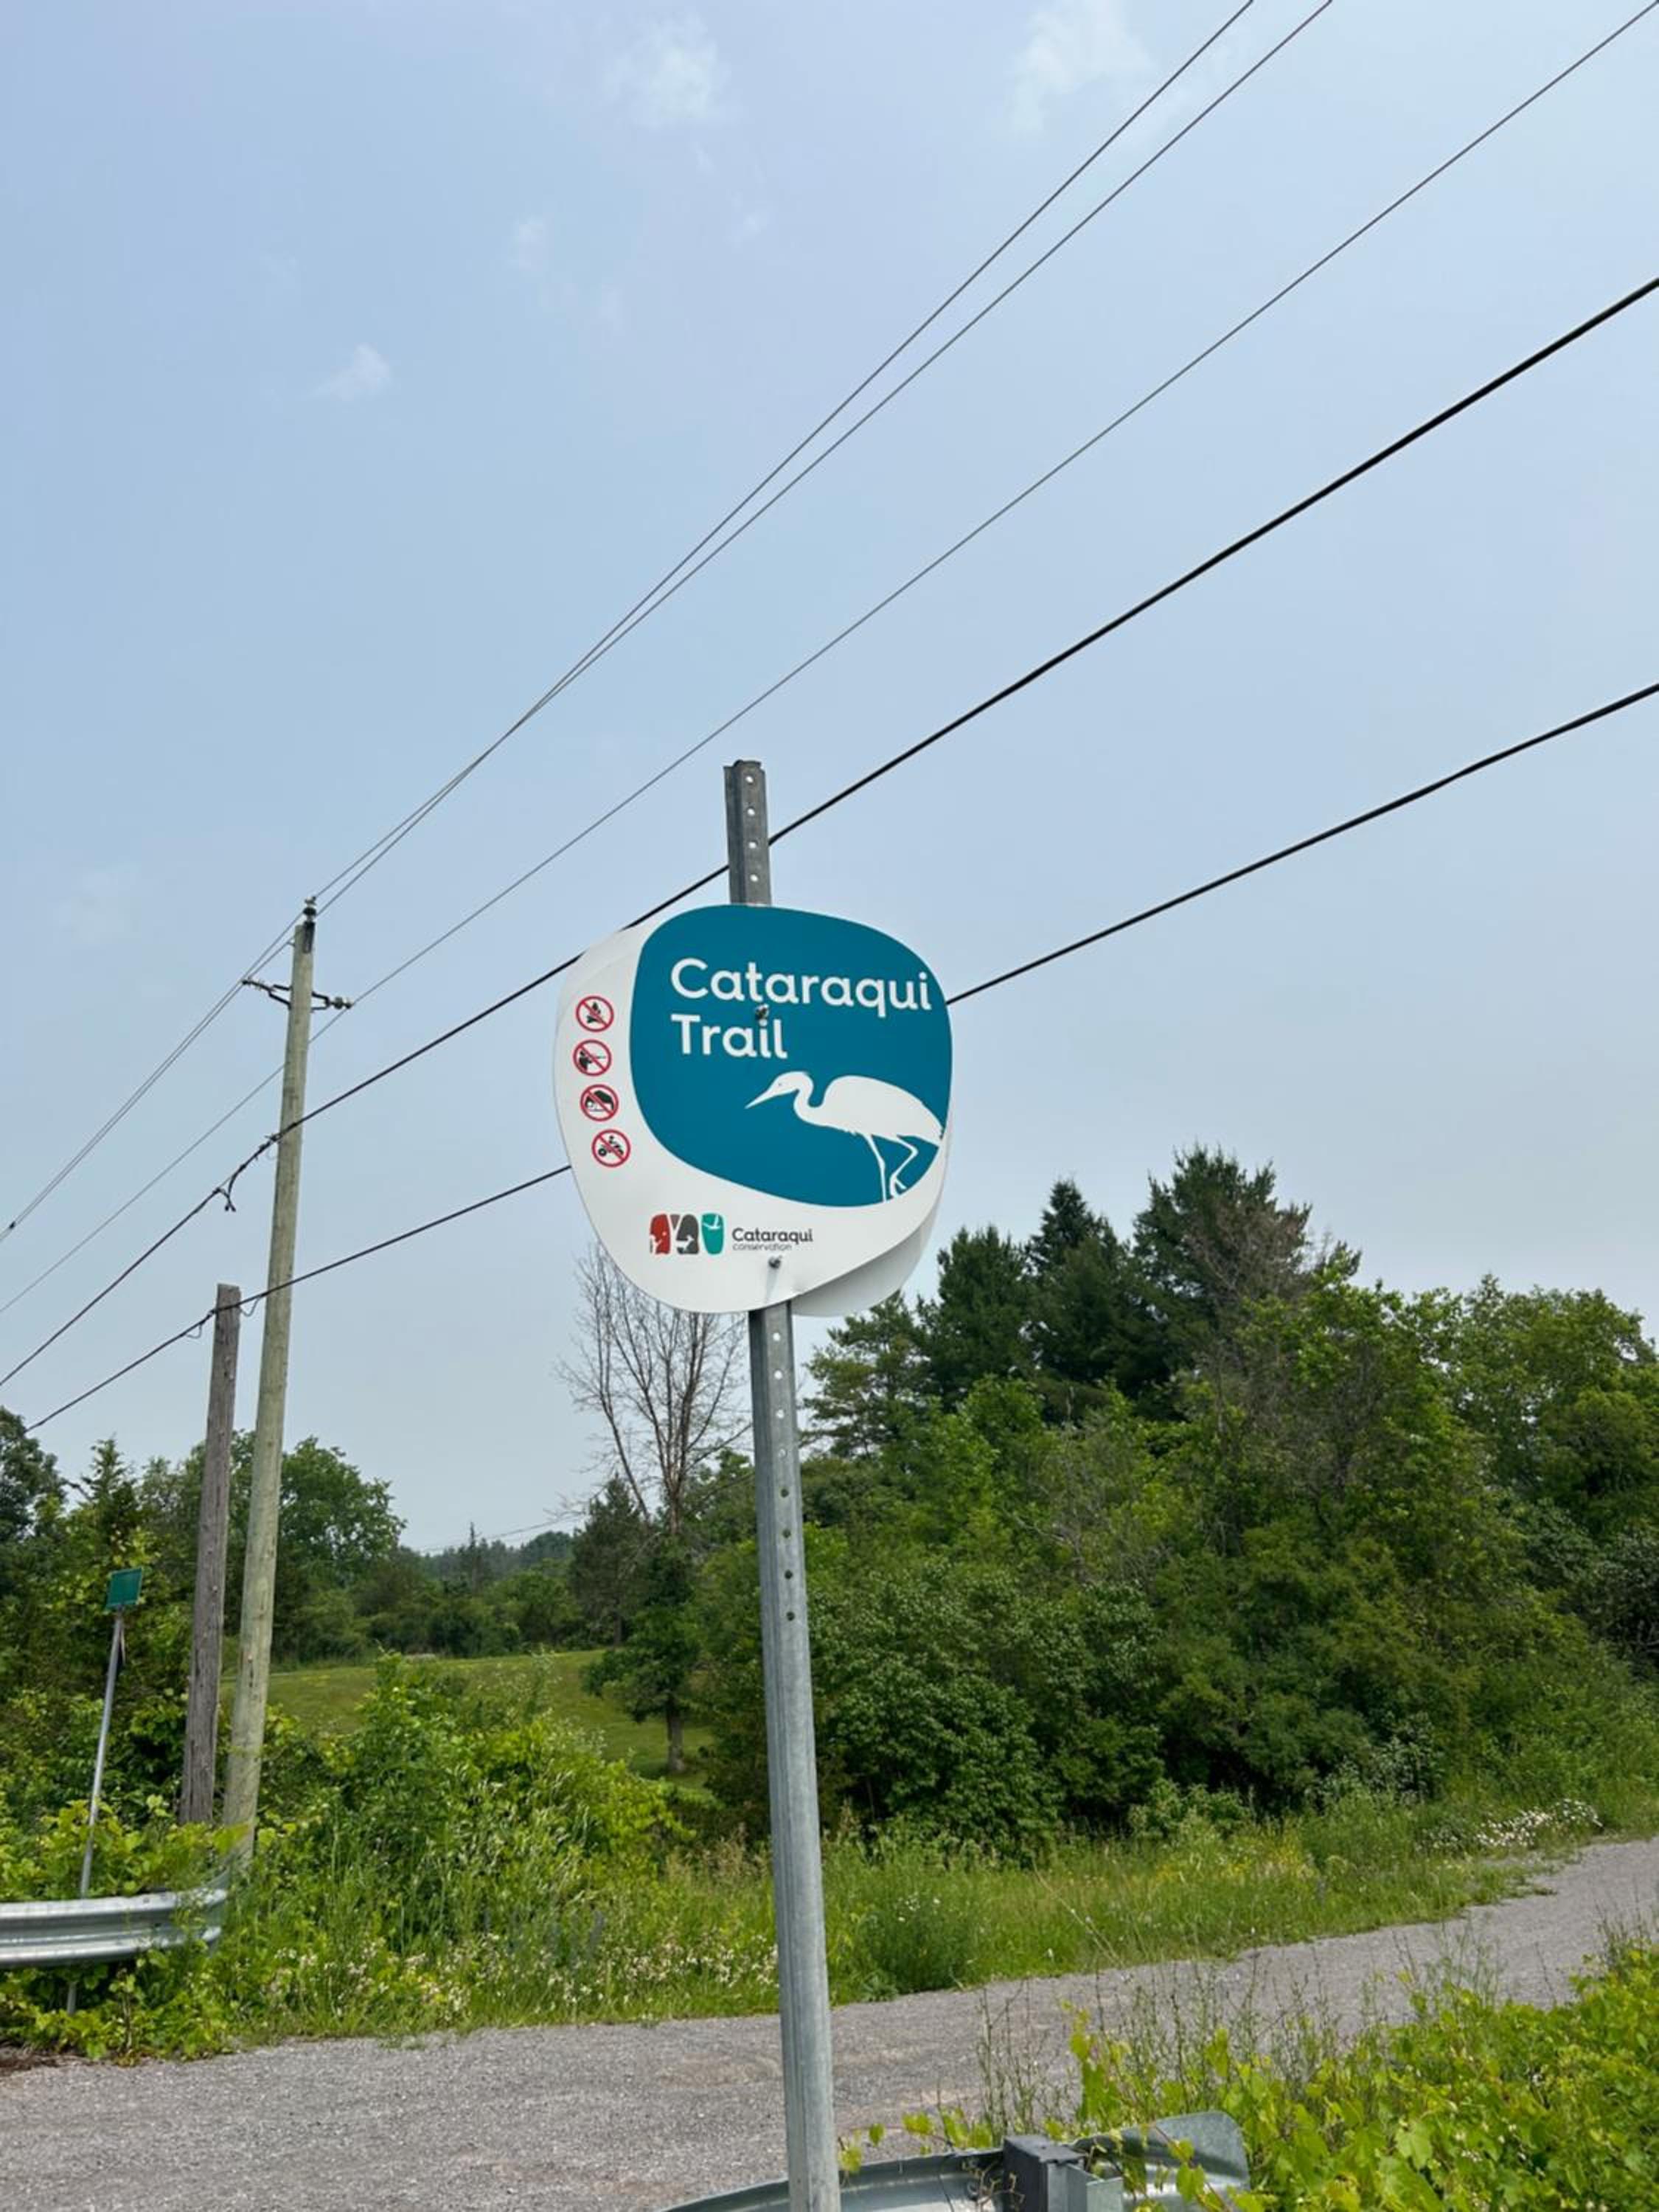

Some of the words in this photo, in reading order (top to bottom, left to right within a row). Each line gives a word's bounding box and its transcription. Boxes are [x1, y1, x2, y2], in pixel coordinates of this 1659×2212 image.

[670, 957, 932, 1018] Cataraqui
[670, 1013, 788, 1060] Trail
[732, 1228, 813, 1245] Cataraqui
[732, 1243, 792, 1251] conservation
